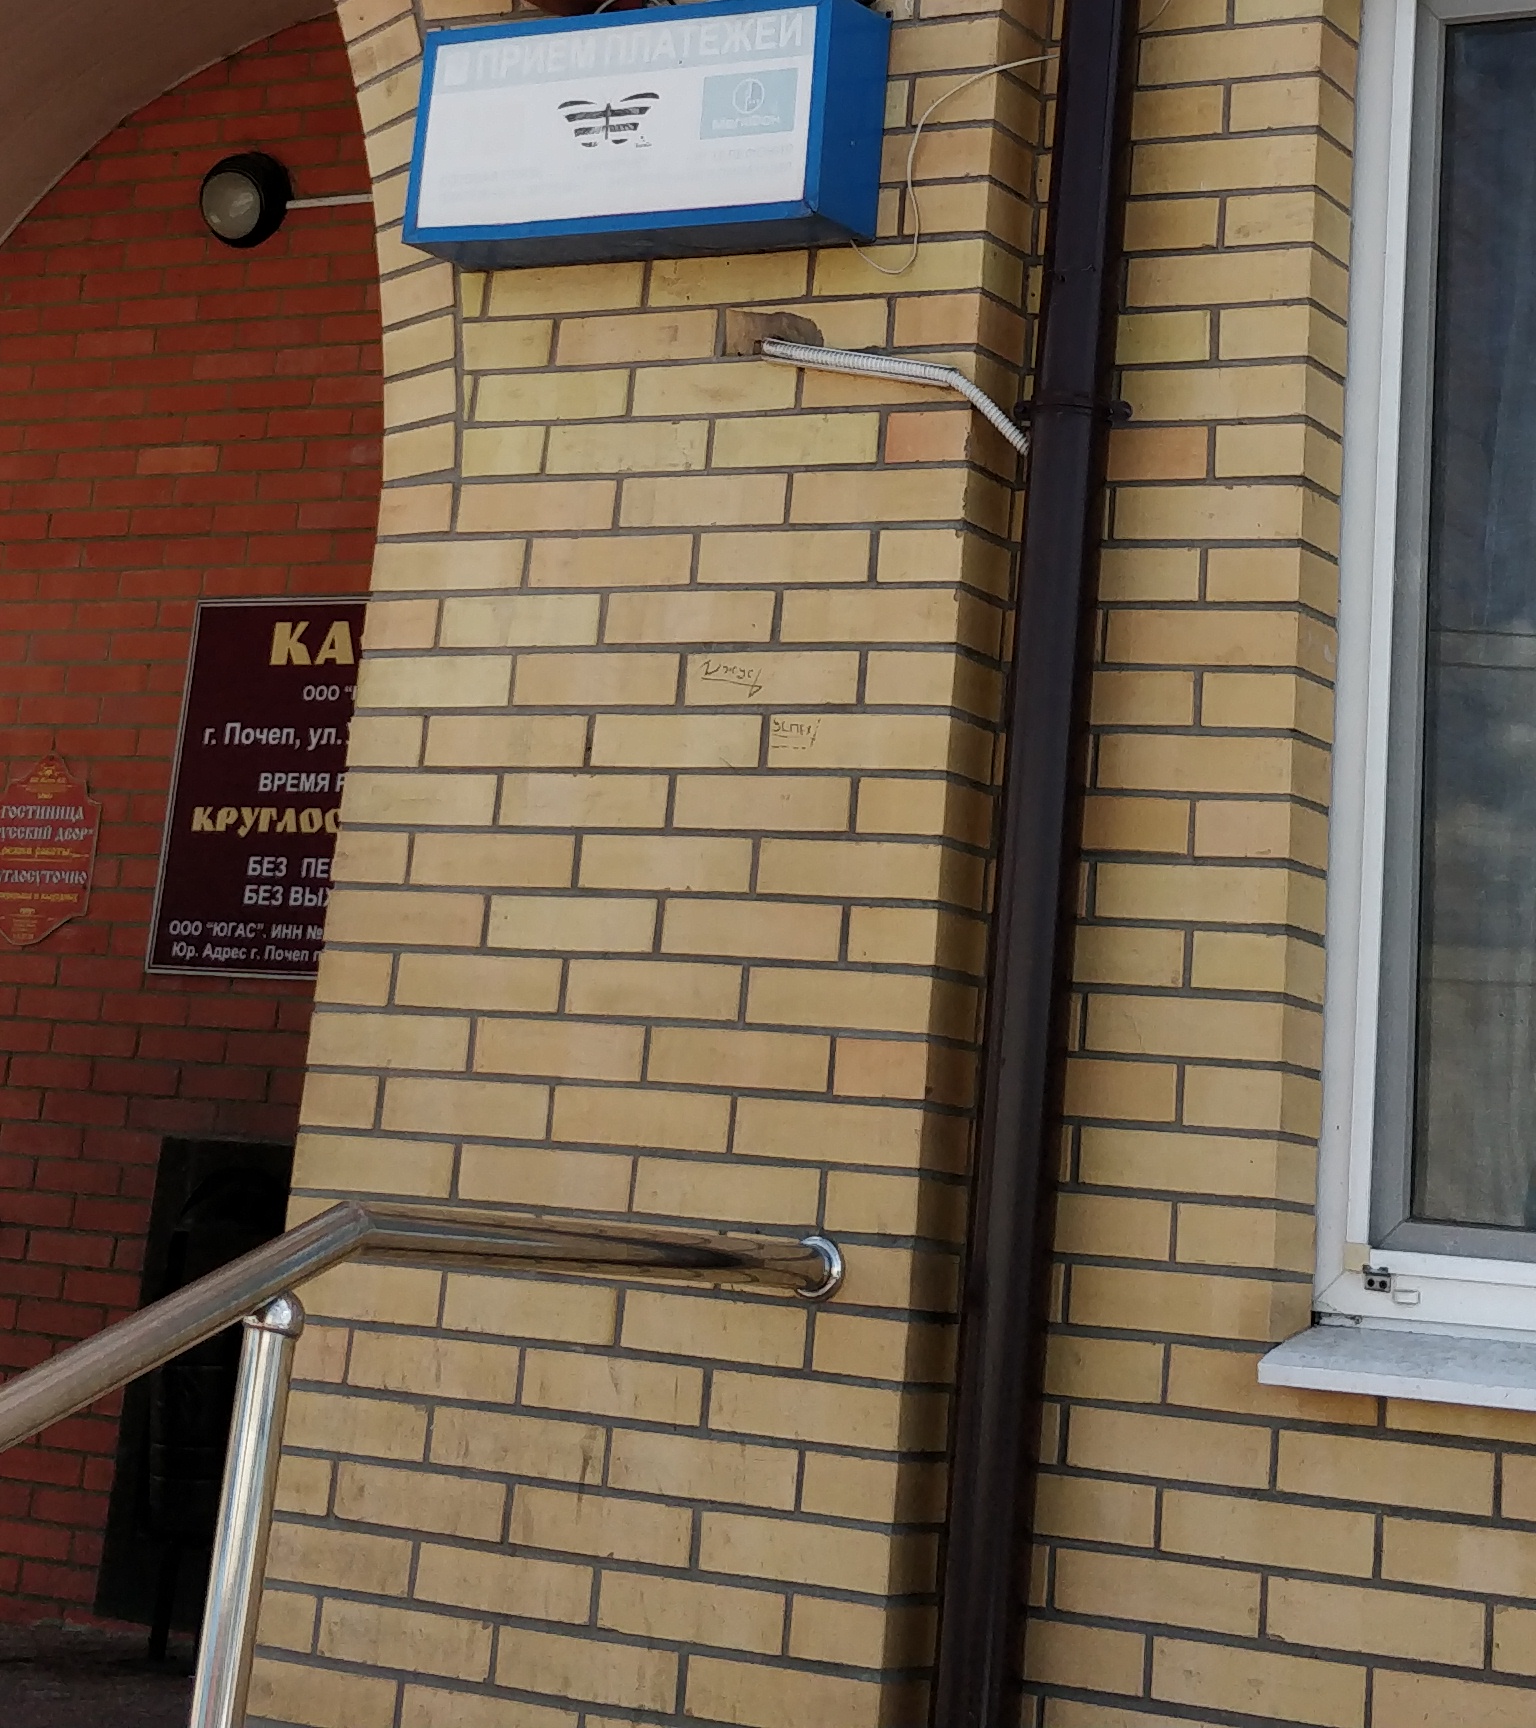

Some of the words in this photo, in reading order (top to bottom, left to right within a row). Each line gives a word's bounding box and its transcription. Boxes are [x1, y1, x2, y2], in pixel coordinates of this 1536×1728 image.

[474, 36, 596, 79] ПРИЕМ
[269, 620, 355, 666] КА
[224, 721, 302, 750] Почеп,
[307, 726, 343, 751] ул.
[258, 772, 329, 793] ВРЕМЯ
[0, 804, 85, 823] ГОСТИНИЦА
[190, 805, 341, 838] КРУГЛОС
[246, 855, 287, 877] БЕЗ
[300, 857, 331, 878] ПЕ
[242, 884, 283, 906] БЕЗ
[270, 924, 302, 941] ИНН
[171, 940, 198, 961] Юр.
[202, 942, 247, 962] Адрес
[263, 944, 309, 963] Почеп
